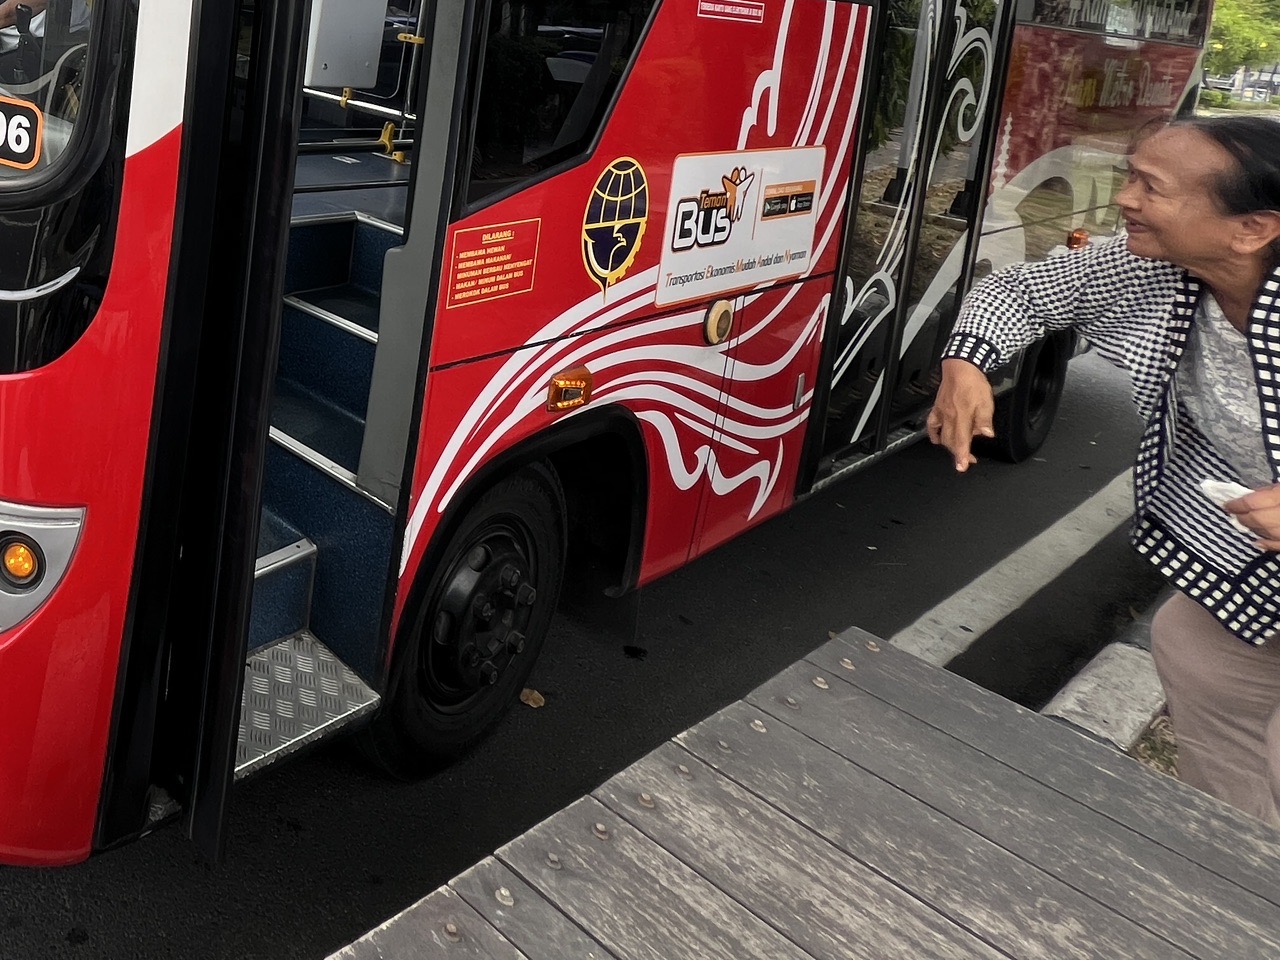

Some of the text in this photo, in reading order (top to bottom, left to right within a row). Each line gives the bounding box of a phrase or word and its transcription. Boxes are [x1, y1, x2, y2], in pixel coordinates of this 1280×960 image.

[700, 193, 727, 210] Teman
[482, 230, 512, 241] DILARANG
[513, 270, 524, 278] BUS
[665, 268, 706, 288] Transportasi
[705, 264, 736, 280] Ekonomis
[735, 258, 756, 273] Mudah
[757, 253, 773, 268] Andal
[773, 252, 784, 265] dan
[499, 283, 510, 291] BUS
